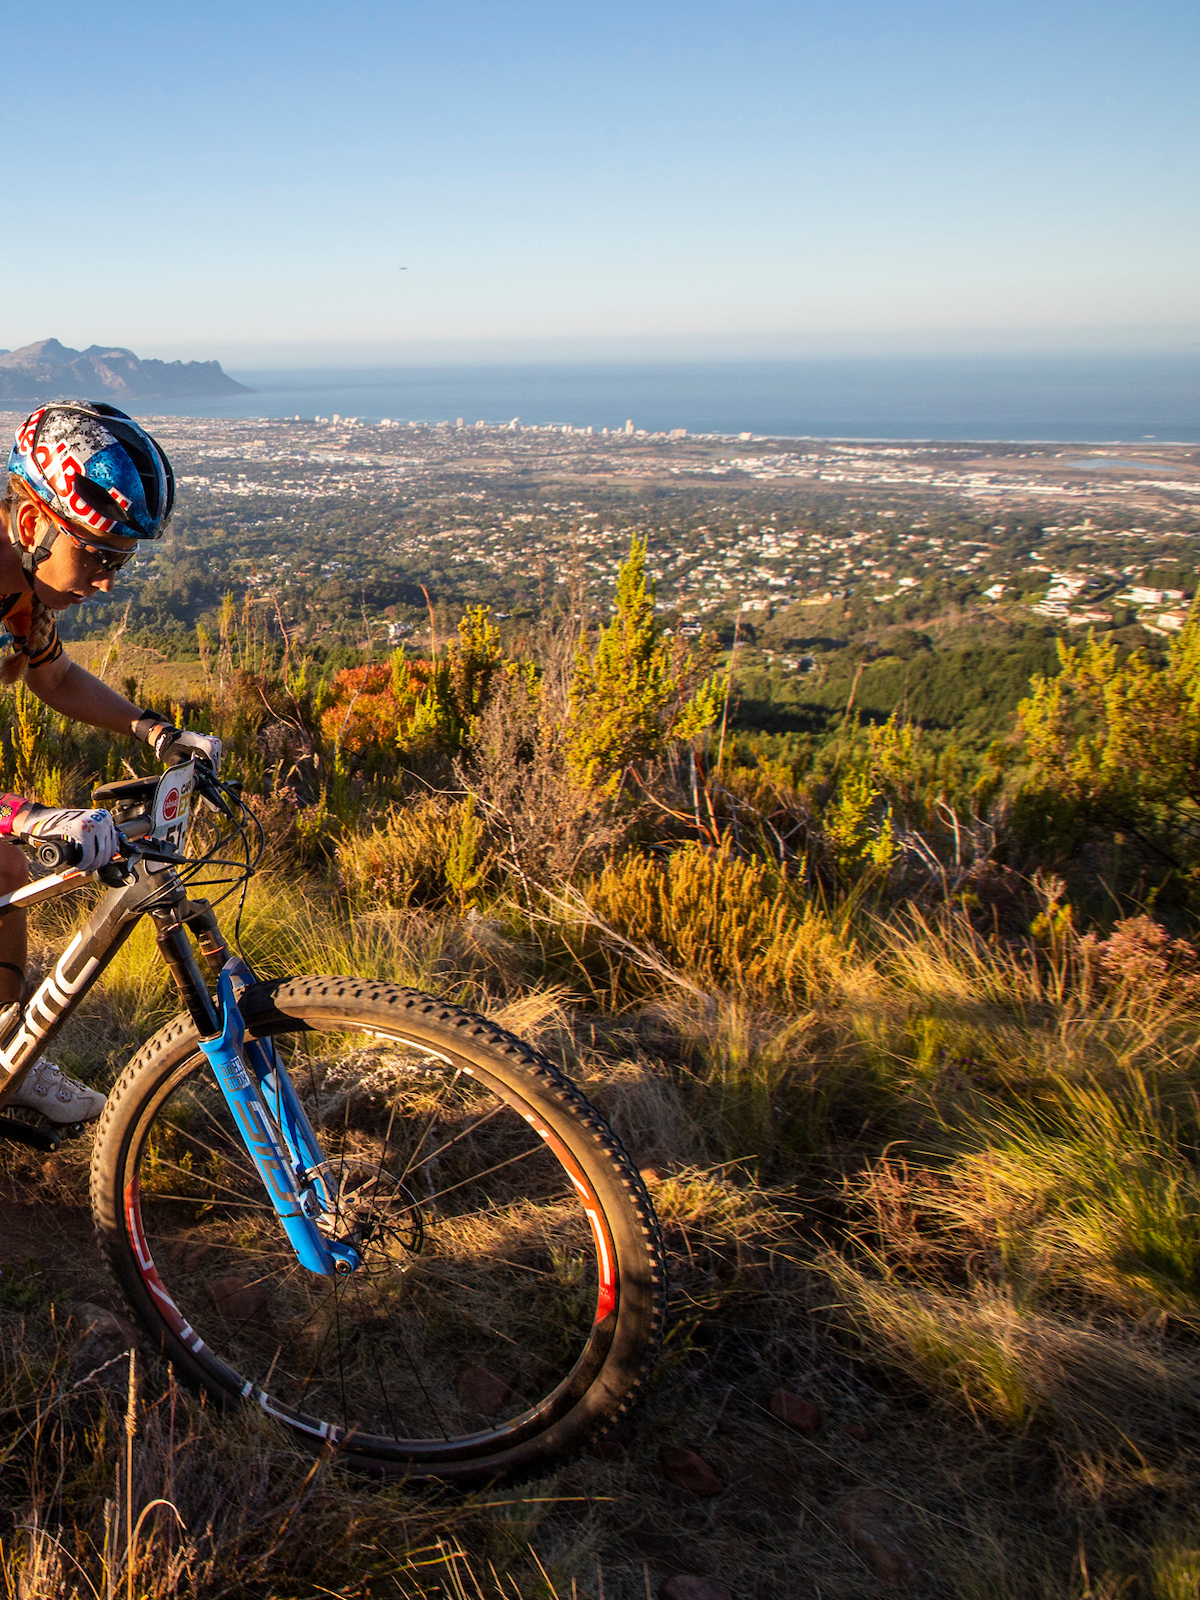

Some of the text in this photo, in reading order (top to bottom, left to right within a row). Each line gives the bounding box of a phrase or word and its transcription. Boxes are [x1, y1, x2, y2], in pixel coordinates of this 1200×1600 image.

[166, 821, 187, 850] 51-
[220, 1058, 244, 1078] ROCK
[226, 1071, 252, 1091] SHOX
[233, 1099, 300, 1203] SID
